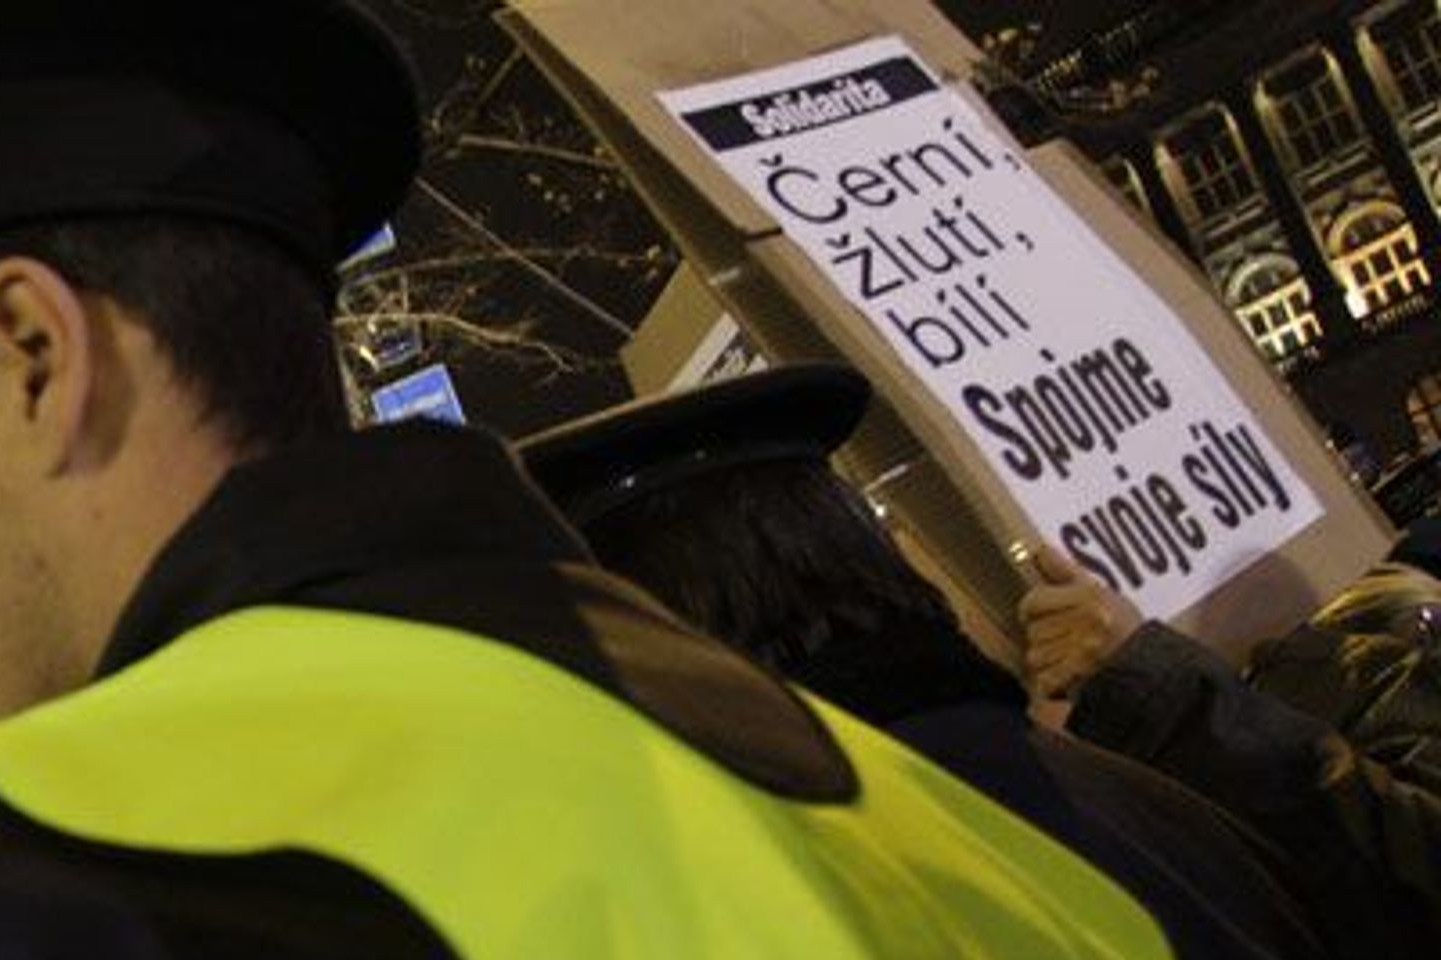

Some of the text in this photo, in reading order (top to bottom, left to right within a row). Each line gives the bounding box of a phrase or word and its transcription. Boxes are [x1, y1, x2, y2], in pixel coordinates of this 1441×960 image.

[740, 75, 893, 139] Solidarita
[759, 115, 1021, 226] Černí,
[824, 198, 1035, 302] žlutí,
[961, 337, 1173, 481] Spojme
[1060, 420, 1292, 593] svoje síly
